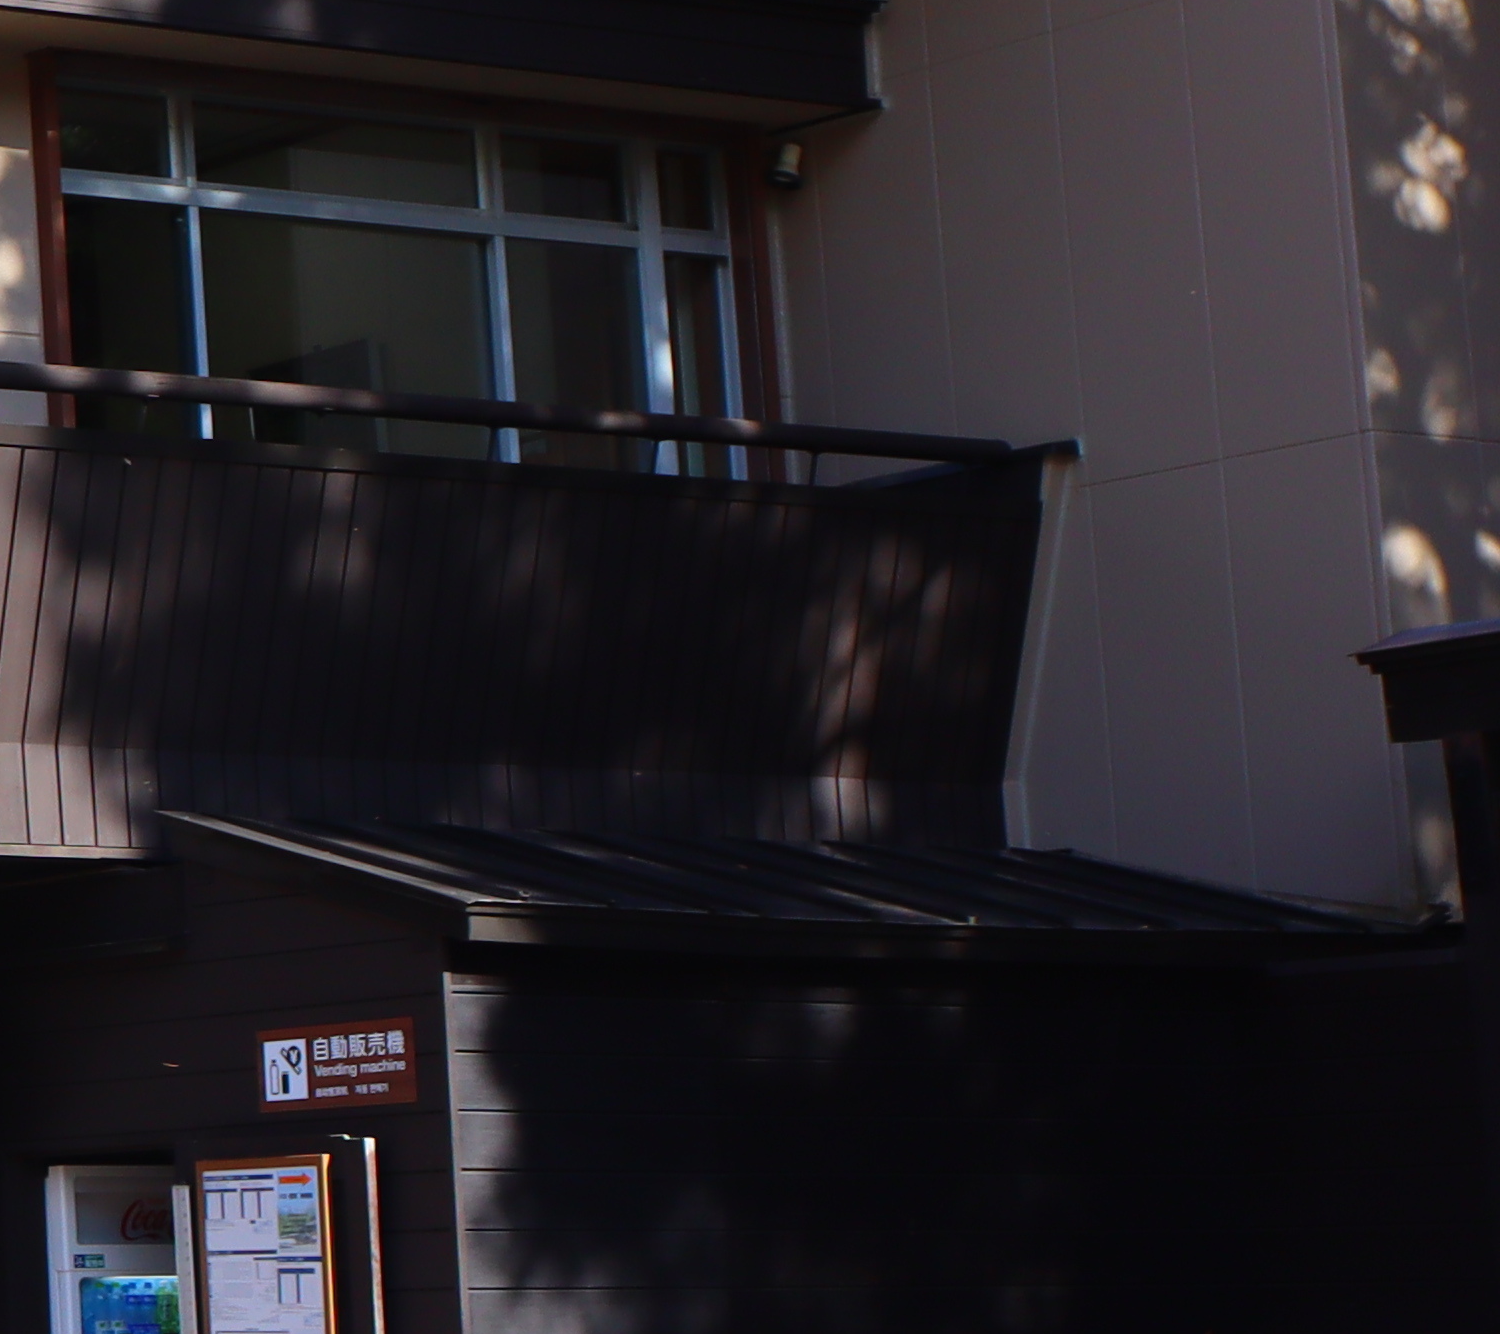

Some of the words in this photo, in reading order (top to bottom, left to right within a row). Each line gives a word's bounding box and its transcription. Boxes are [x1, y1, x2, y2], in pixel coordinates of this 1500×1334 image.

[313, 1029, 405, 1061] 自動販売機
[313, 1063, 358, 1078] Vending
[360, 1059, 407, 1074] machine
